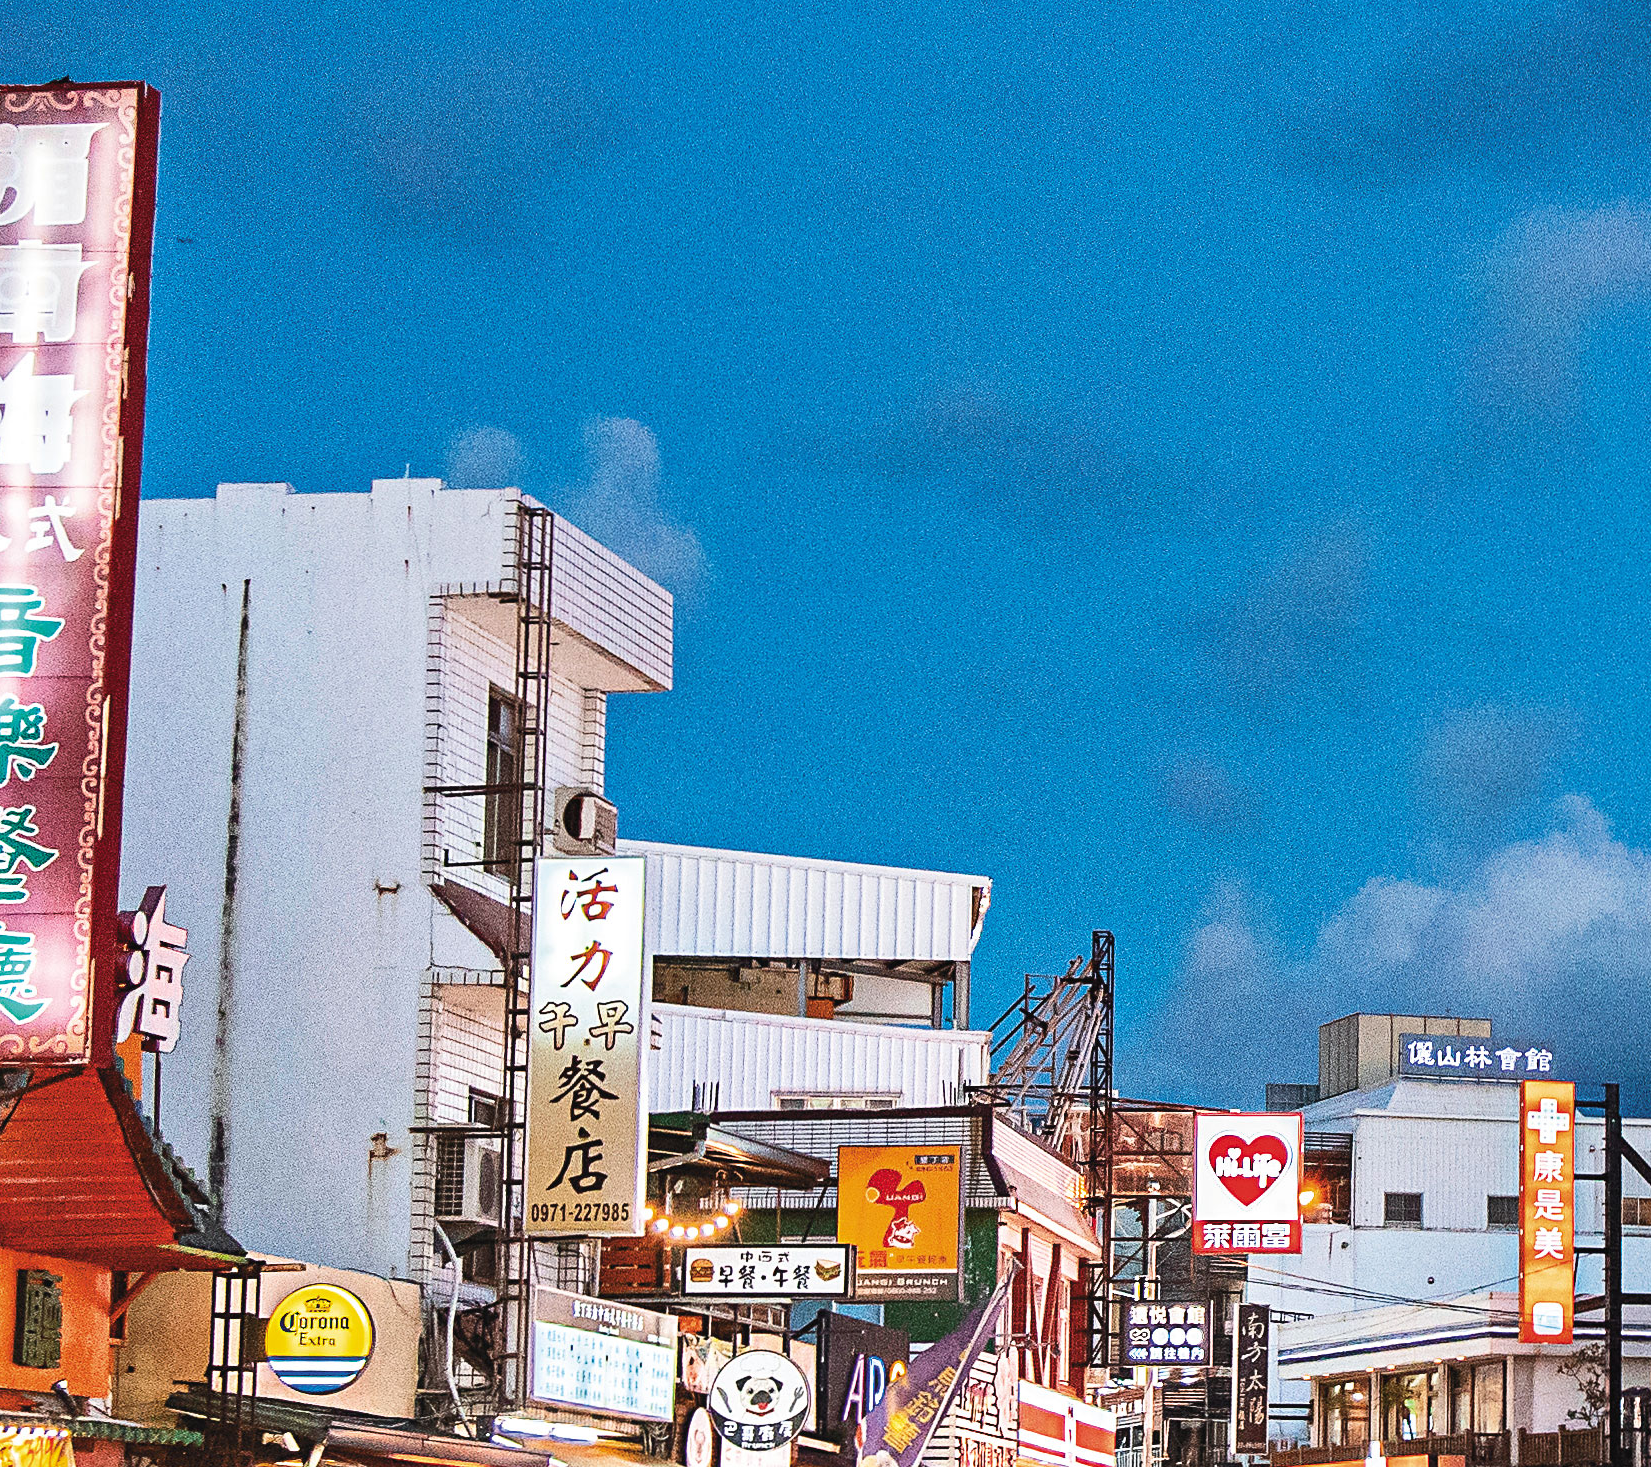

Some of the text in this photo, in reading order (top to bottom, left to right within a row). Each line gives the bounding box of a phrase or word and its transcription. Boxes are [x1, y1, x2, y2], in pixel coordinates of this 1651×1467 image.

[530, 1202, 630, 1223] 0971-227985
[1533, 1150, 1565, 1260] 康是美
[1202, 1222, 1291, 1249] 萊爾富
[279, 1311, 350, 1334] Corona
[297, 1331, 337, 1347] Extra
[1240, 1311, 1267, 1426] 南方太陽
